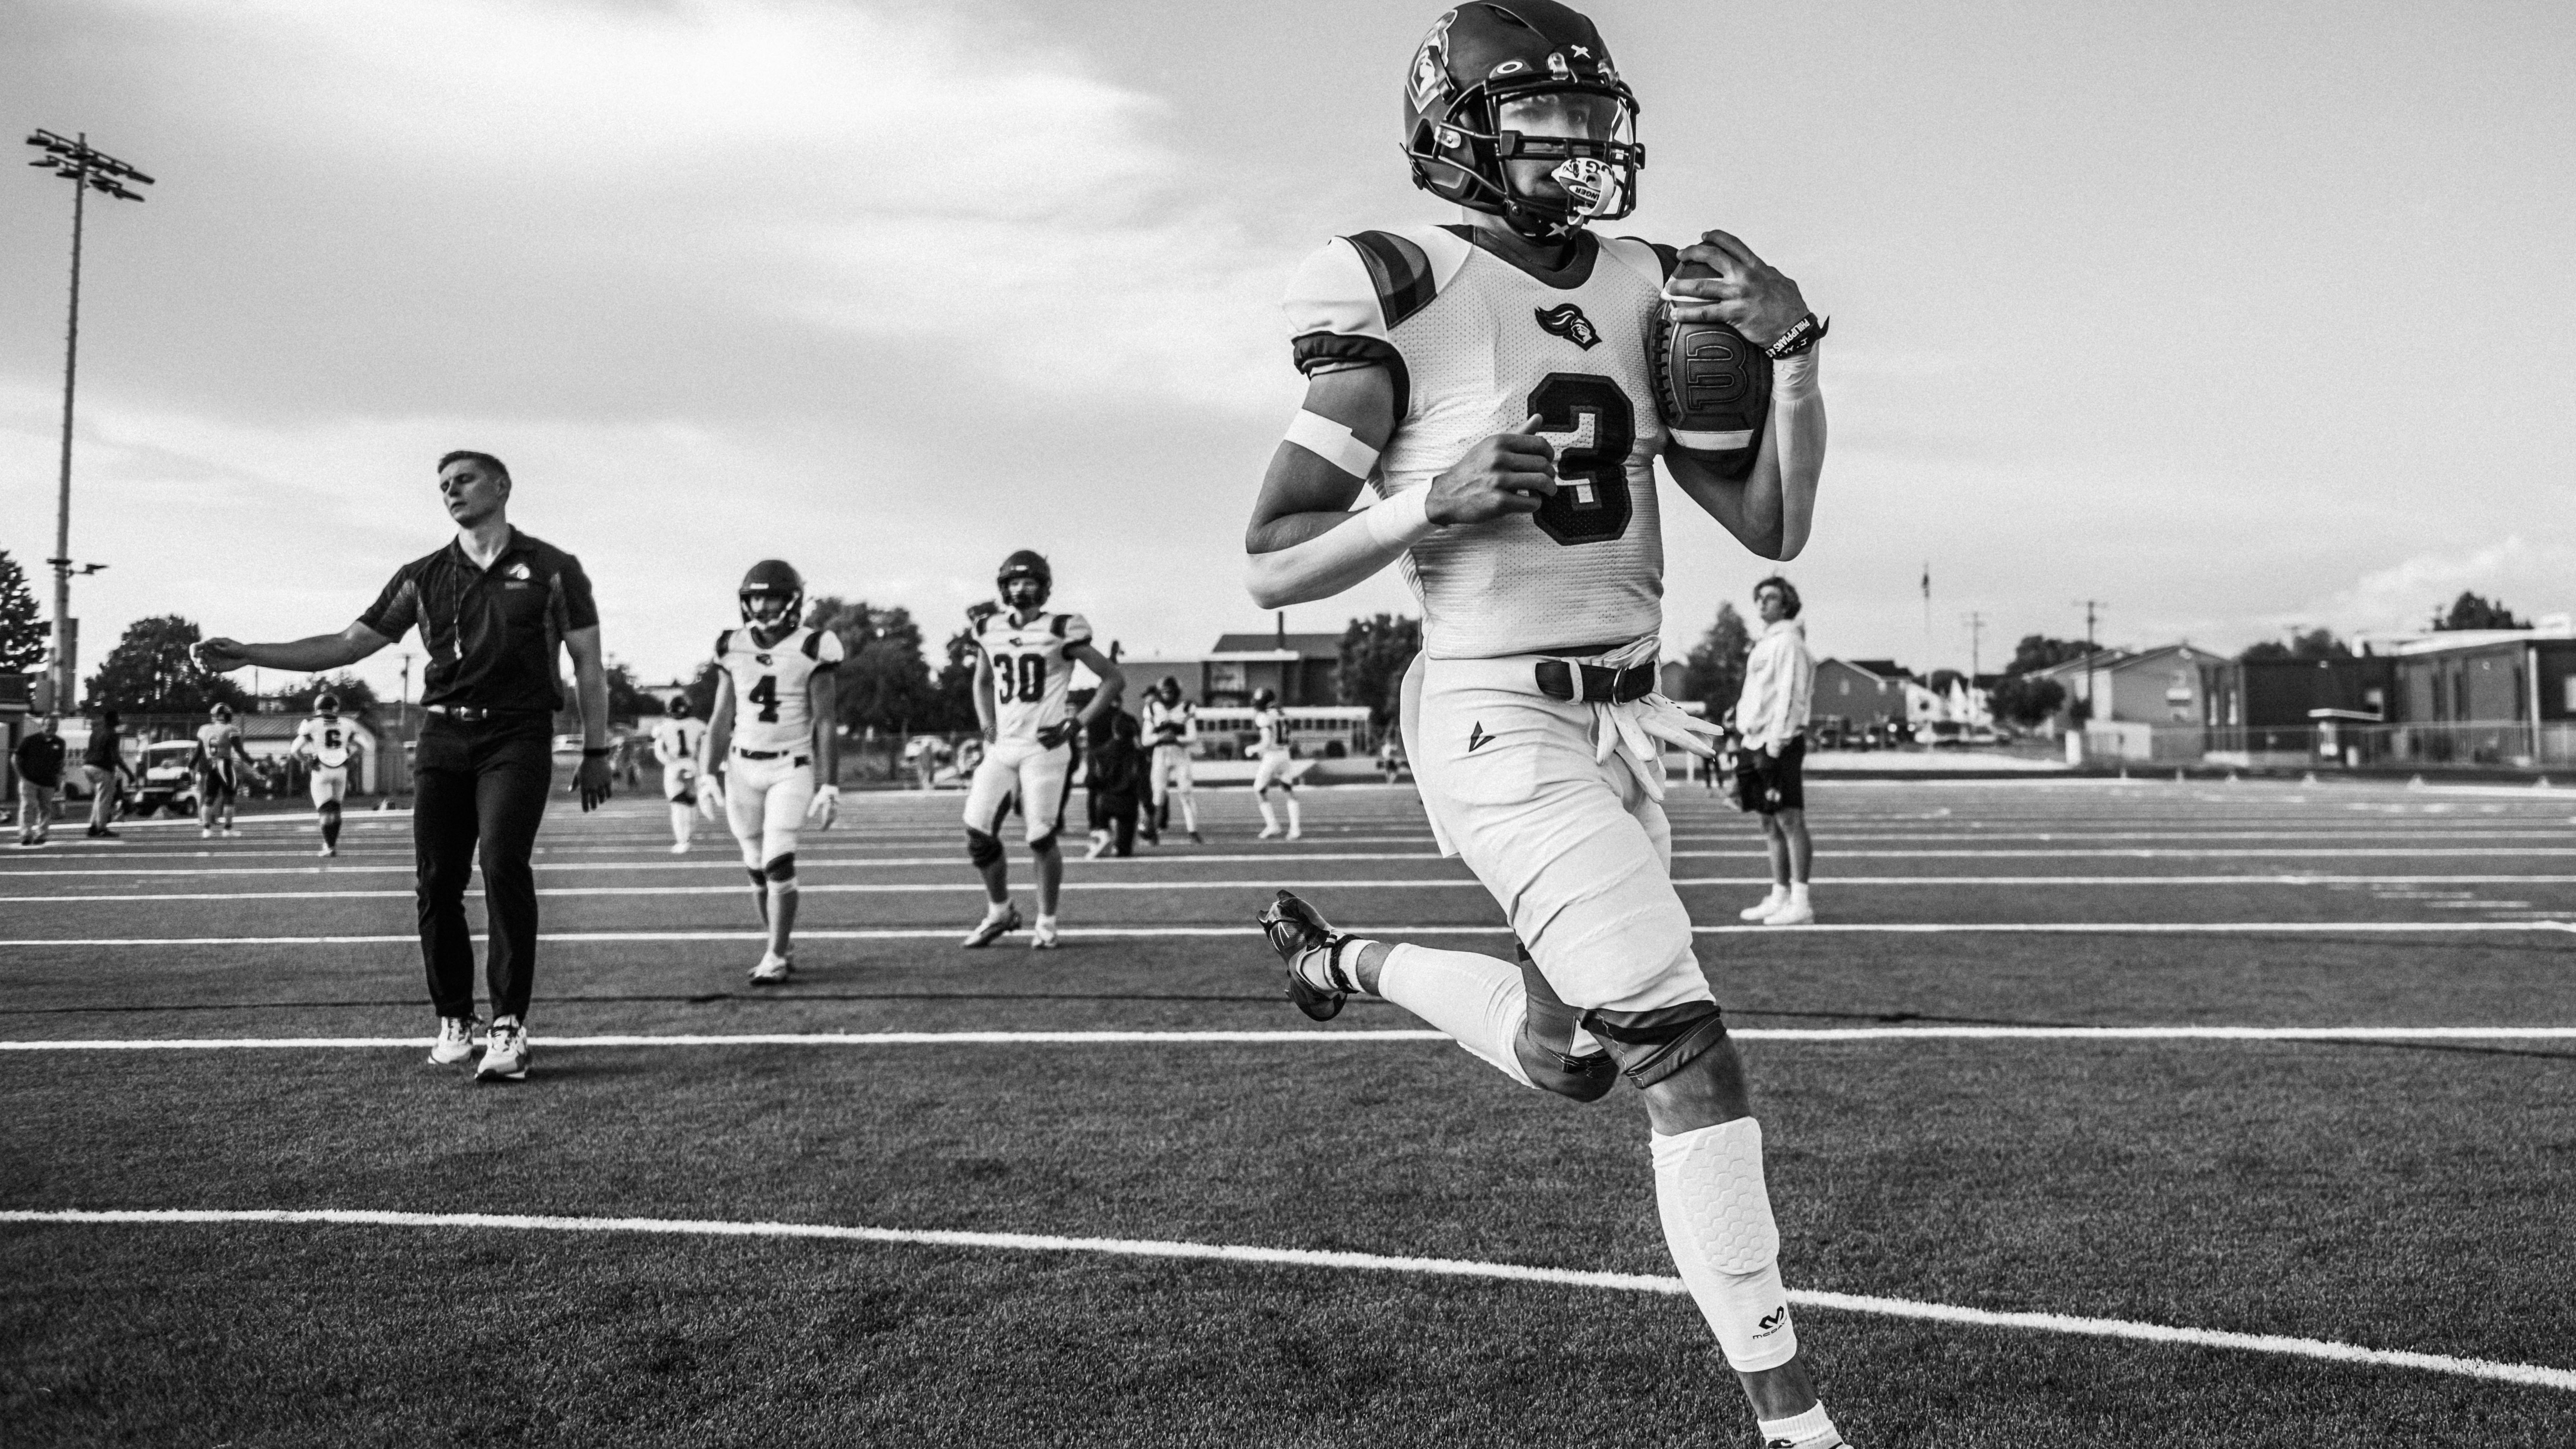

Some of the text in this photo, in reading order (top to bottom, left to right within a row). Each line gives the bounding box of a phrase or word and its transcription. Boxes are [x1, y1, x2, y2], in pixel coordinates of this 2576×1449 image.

[1773, 318, 1810, 352] PHILIPPIANS
[1528, 372, 1636, 546] 3
[749, 675, 780, 723] 4
[994, 653, 1048, 704] 30
[325, 729, 342, 749] 6
[678, 729, 689, 757] 1
